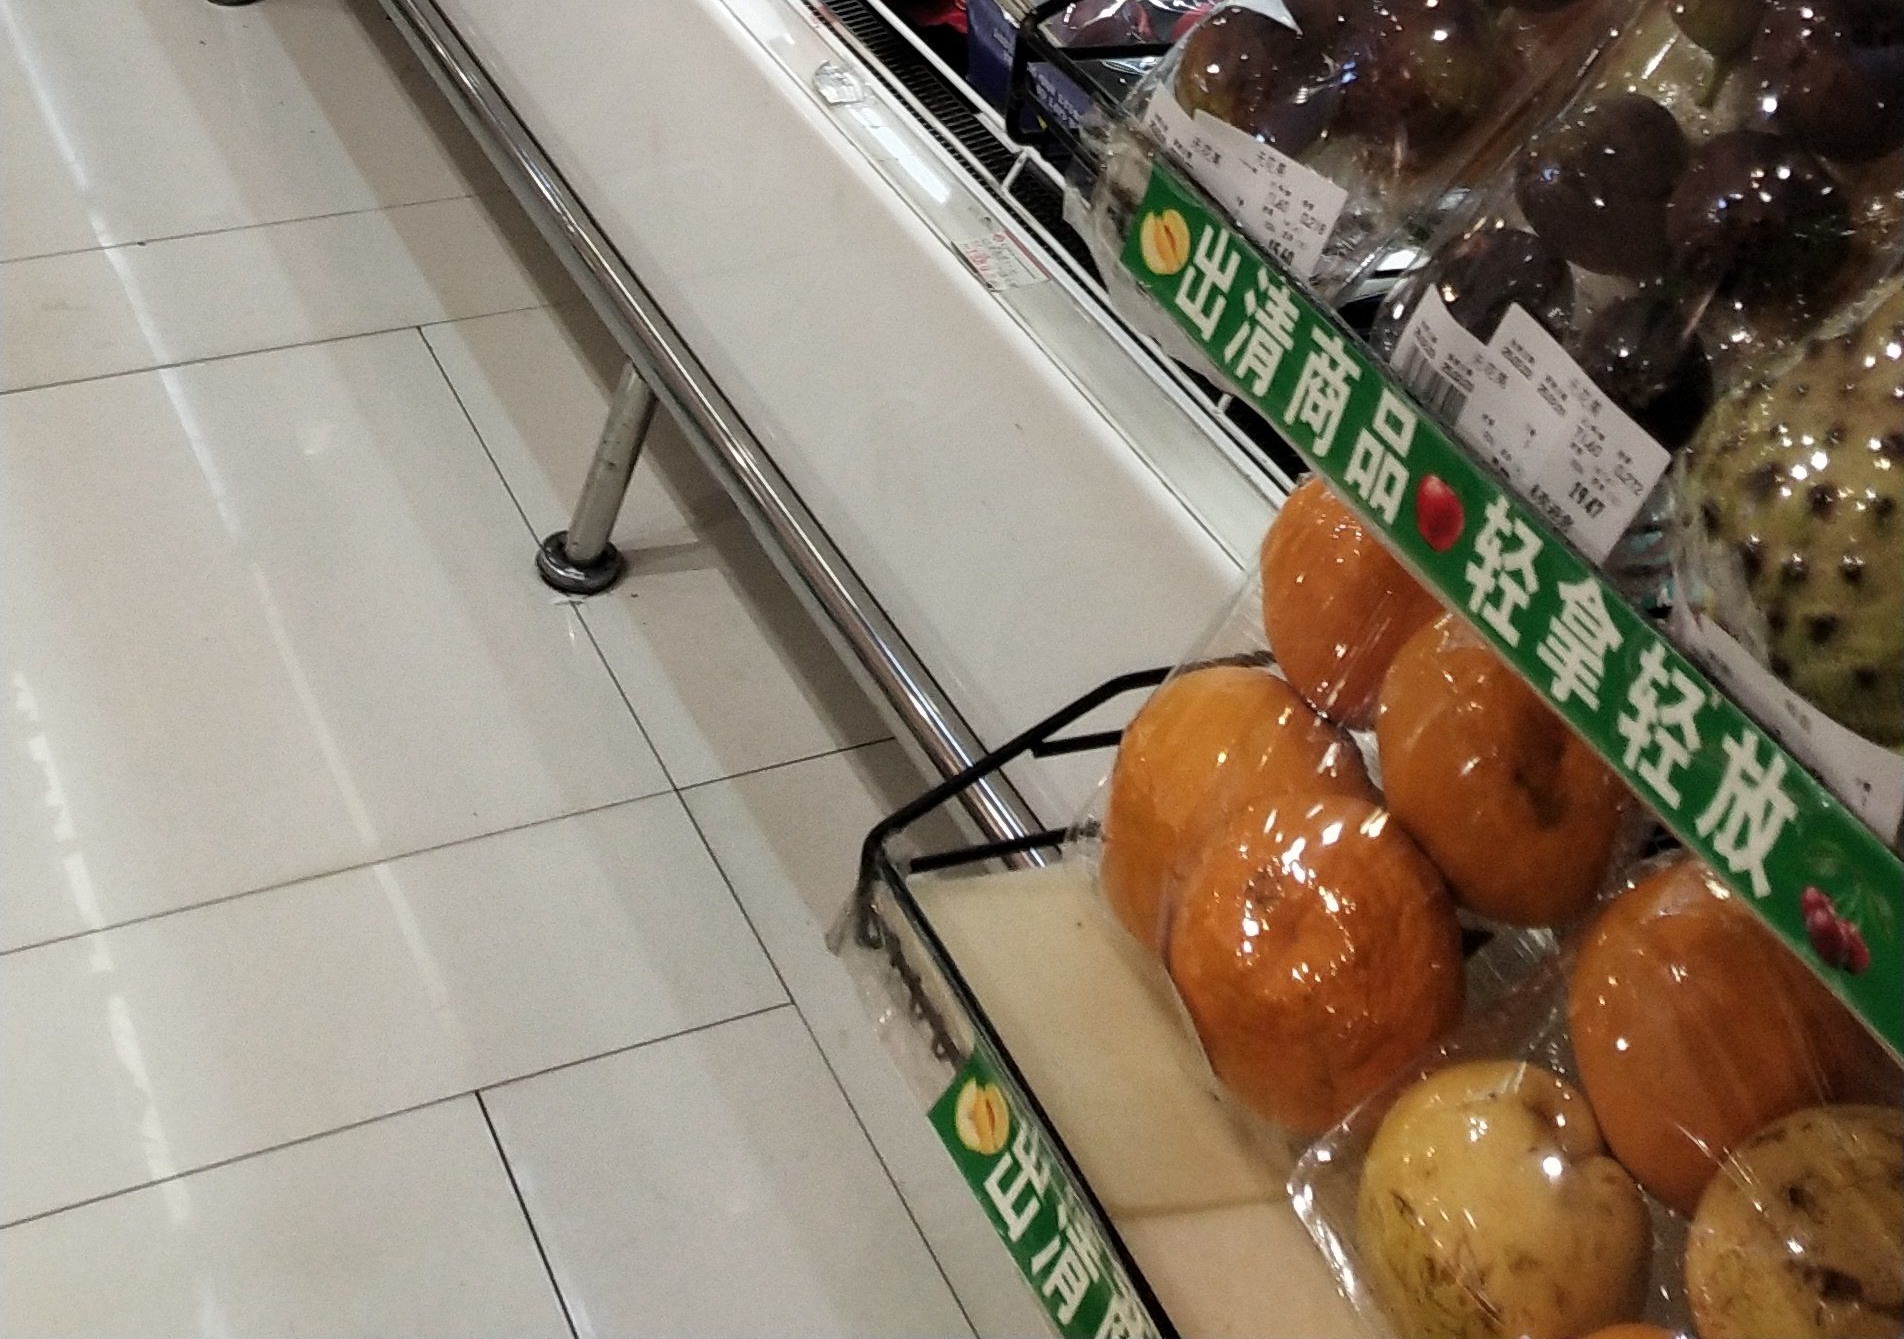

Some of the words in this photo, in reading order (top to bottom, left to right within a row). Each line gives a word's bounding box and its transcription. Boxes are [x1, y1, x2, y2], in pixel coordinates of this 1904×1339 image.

[1174, 224, 1419, 525] 出清商品
[1465, 495, 1799, 899] 轻拿轻放
